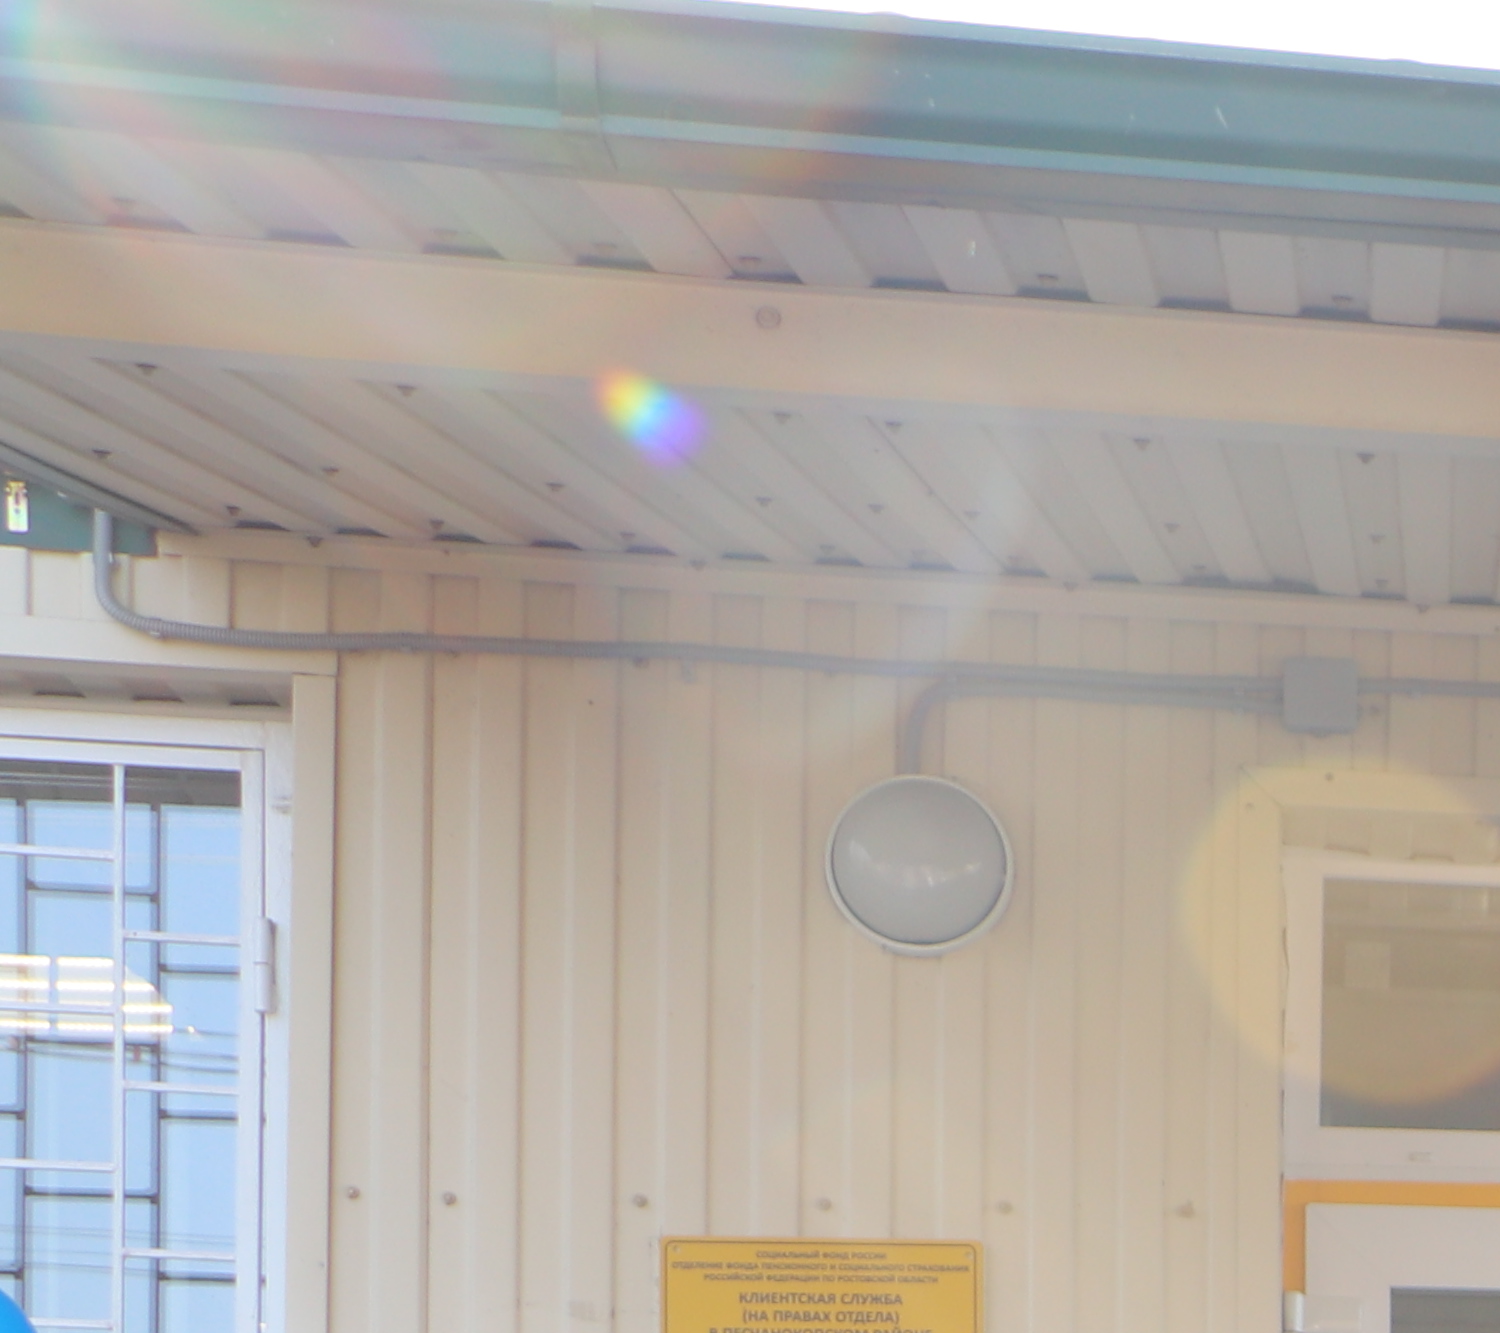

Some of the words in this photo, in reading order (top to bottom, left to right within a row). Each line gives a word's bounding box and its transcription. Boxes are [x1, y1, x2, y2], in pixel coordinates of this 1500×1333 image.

[739, 1292, 836, 1305] КЛИЕНТСКАЯ
[841, 1293, 903, 1306] СЛУЖБА
[743, 1308, 768, 1323] (НА
[774, 1310, 831, 1322] ПРАВАХ
[836, 1311, 900, 1325] ОТДЕЛА)
